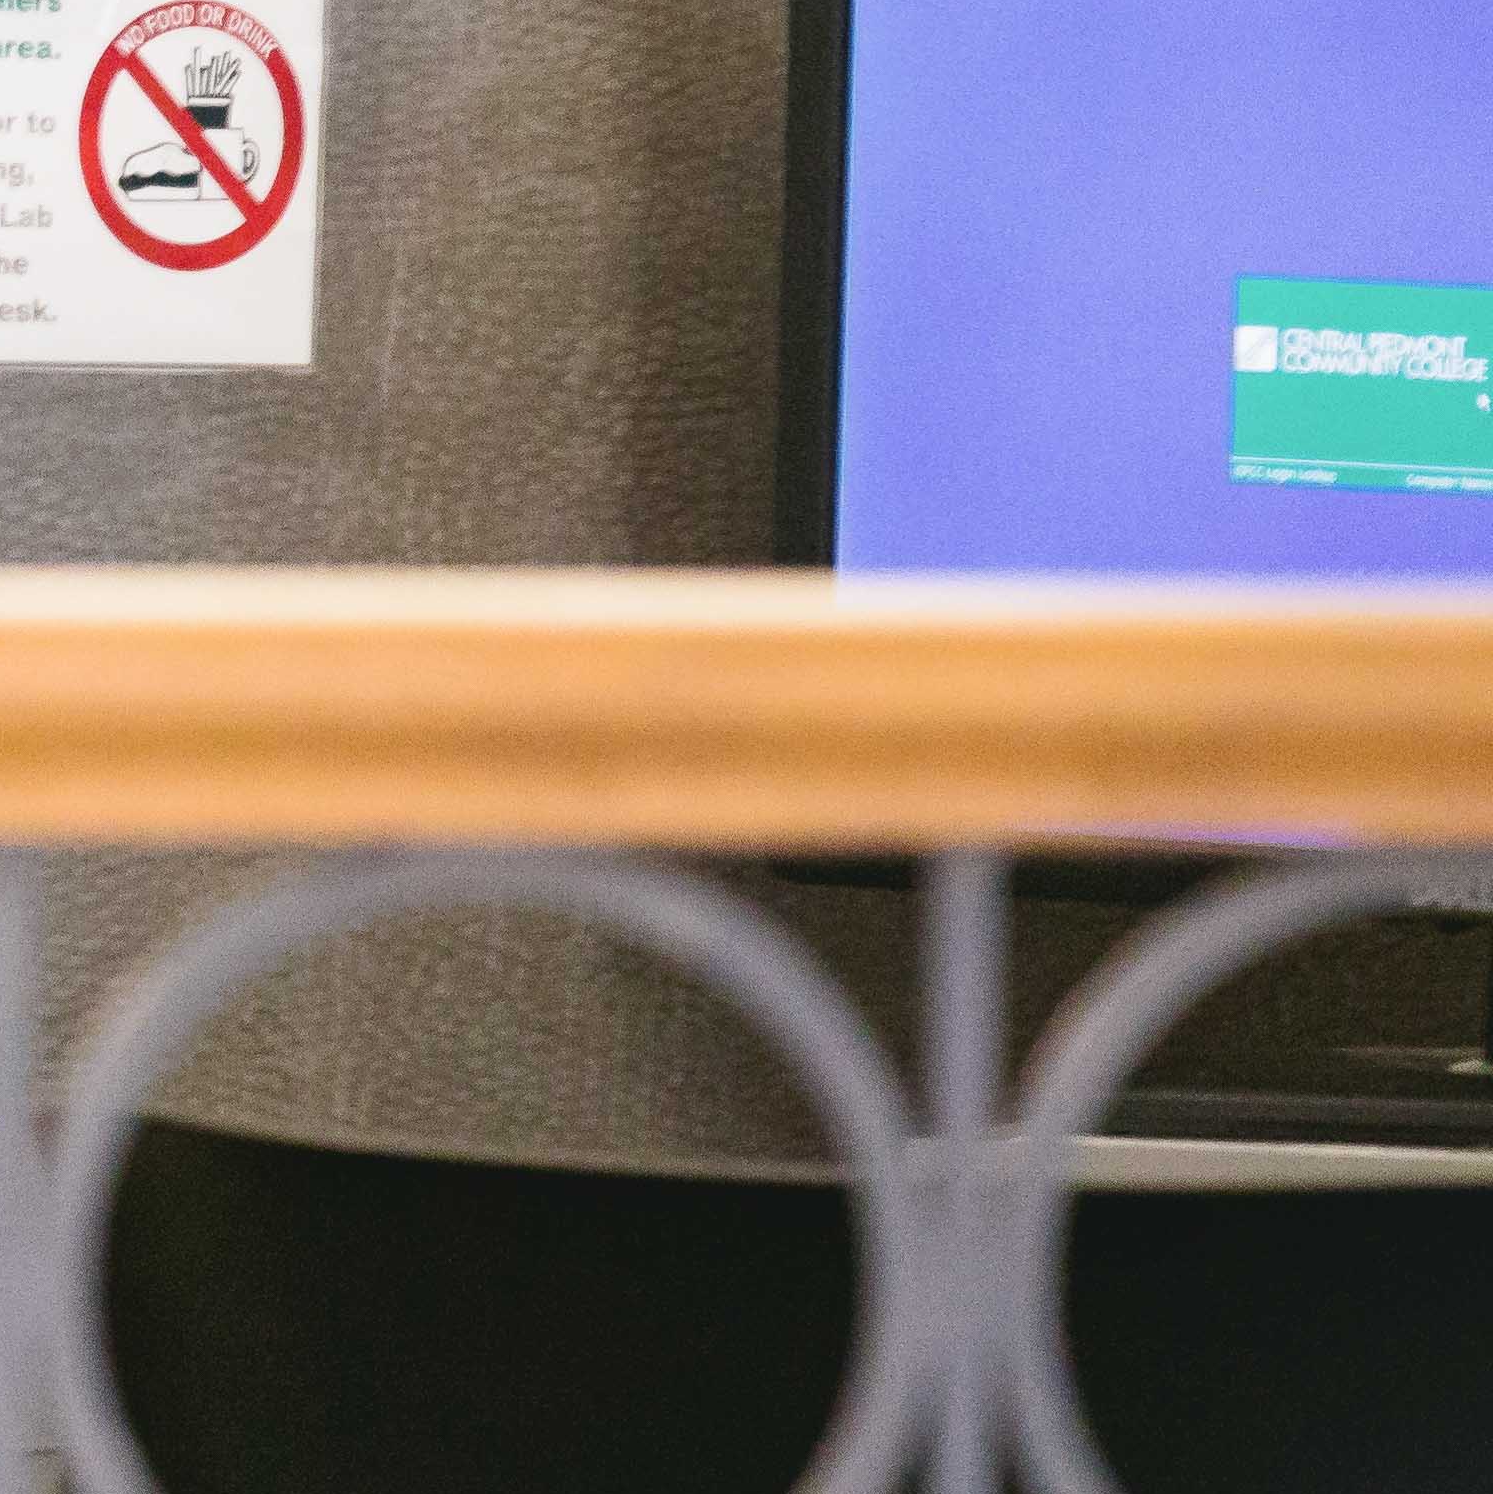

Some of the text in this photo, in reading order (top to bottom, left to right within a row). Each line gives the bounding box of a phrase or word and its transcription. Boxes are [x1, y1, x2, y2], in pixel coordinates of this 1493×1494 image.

[147, 4, 195, 31] FOOD
[199, 4, 225, 26] OR
[226, 10, 280, 59] DRINK
[26, 112, 56, 136] to
[0, 203, 53, 229] Lab
